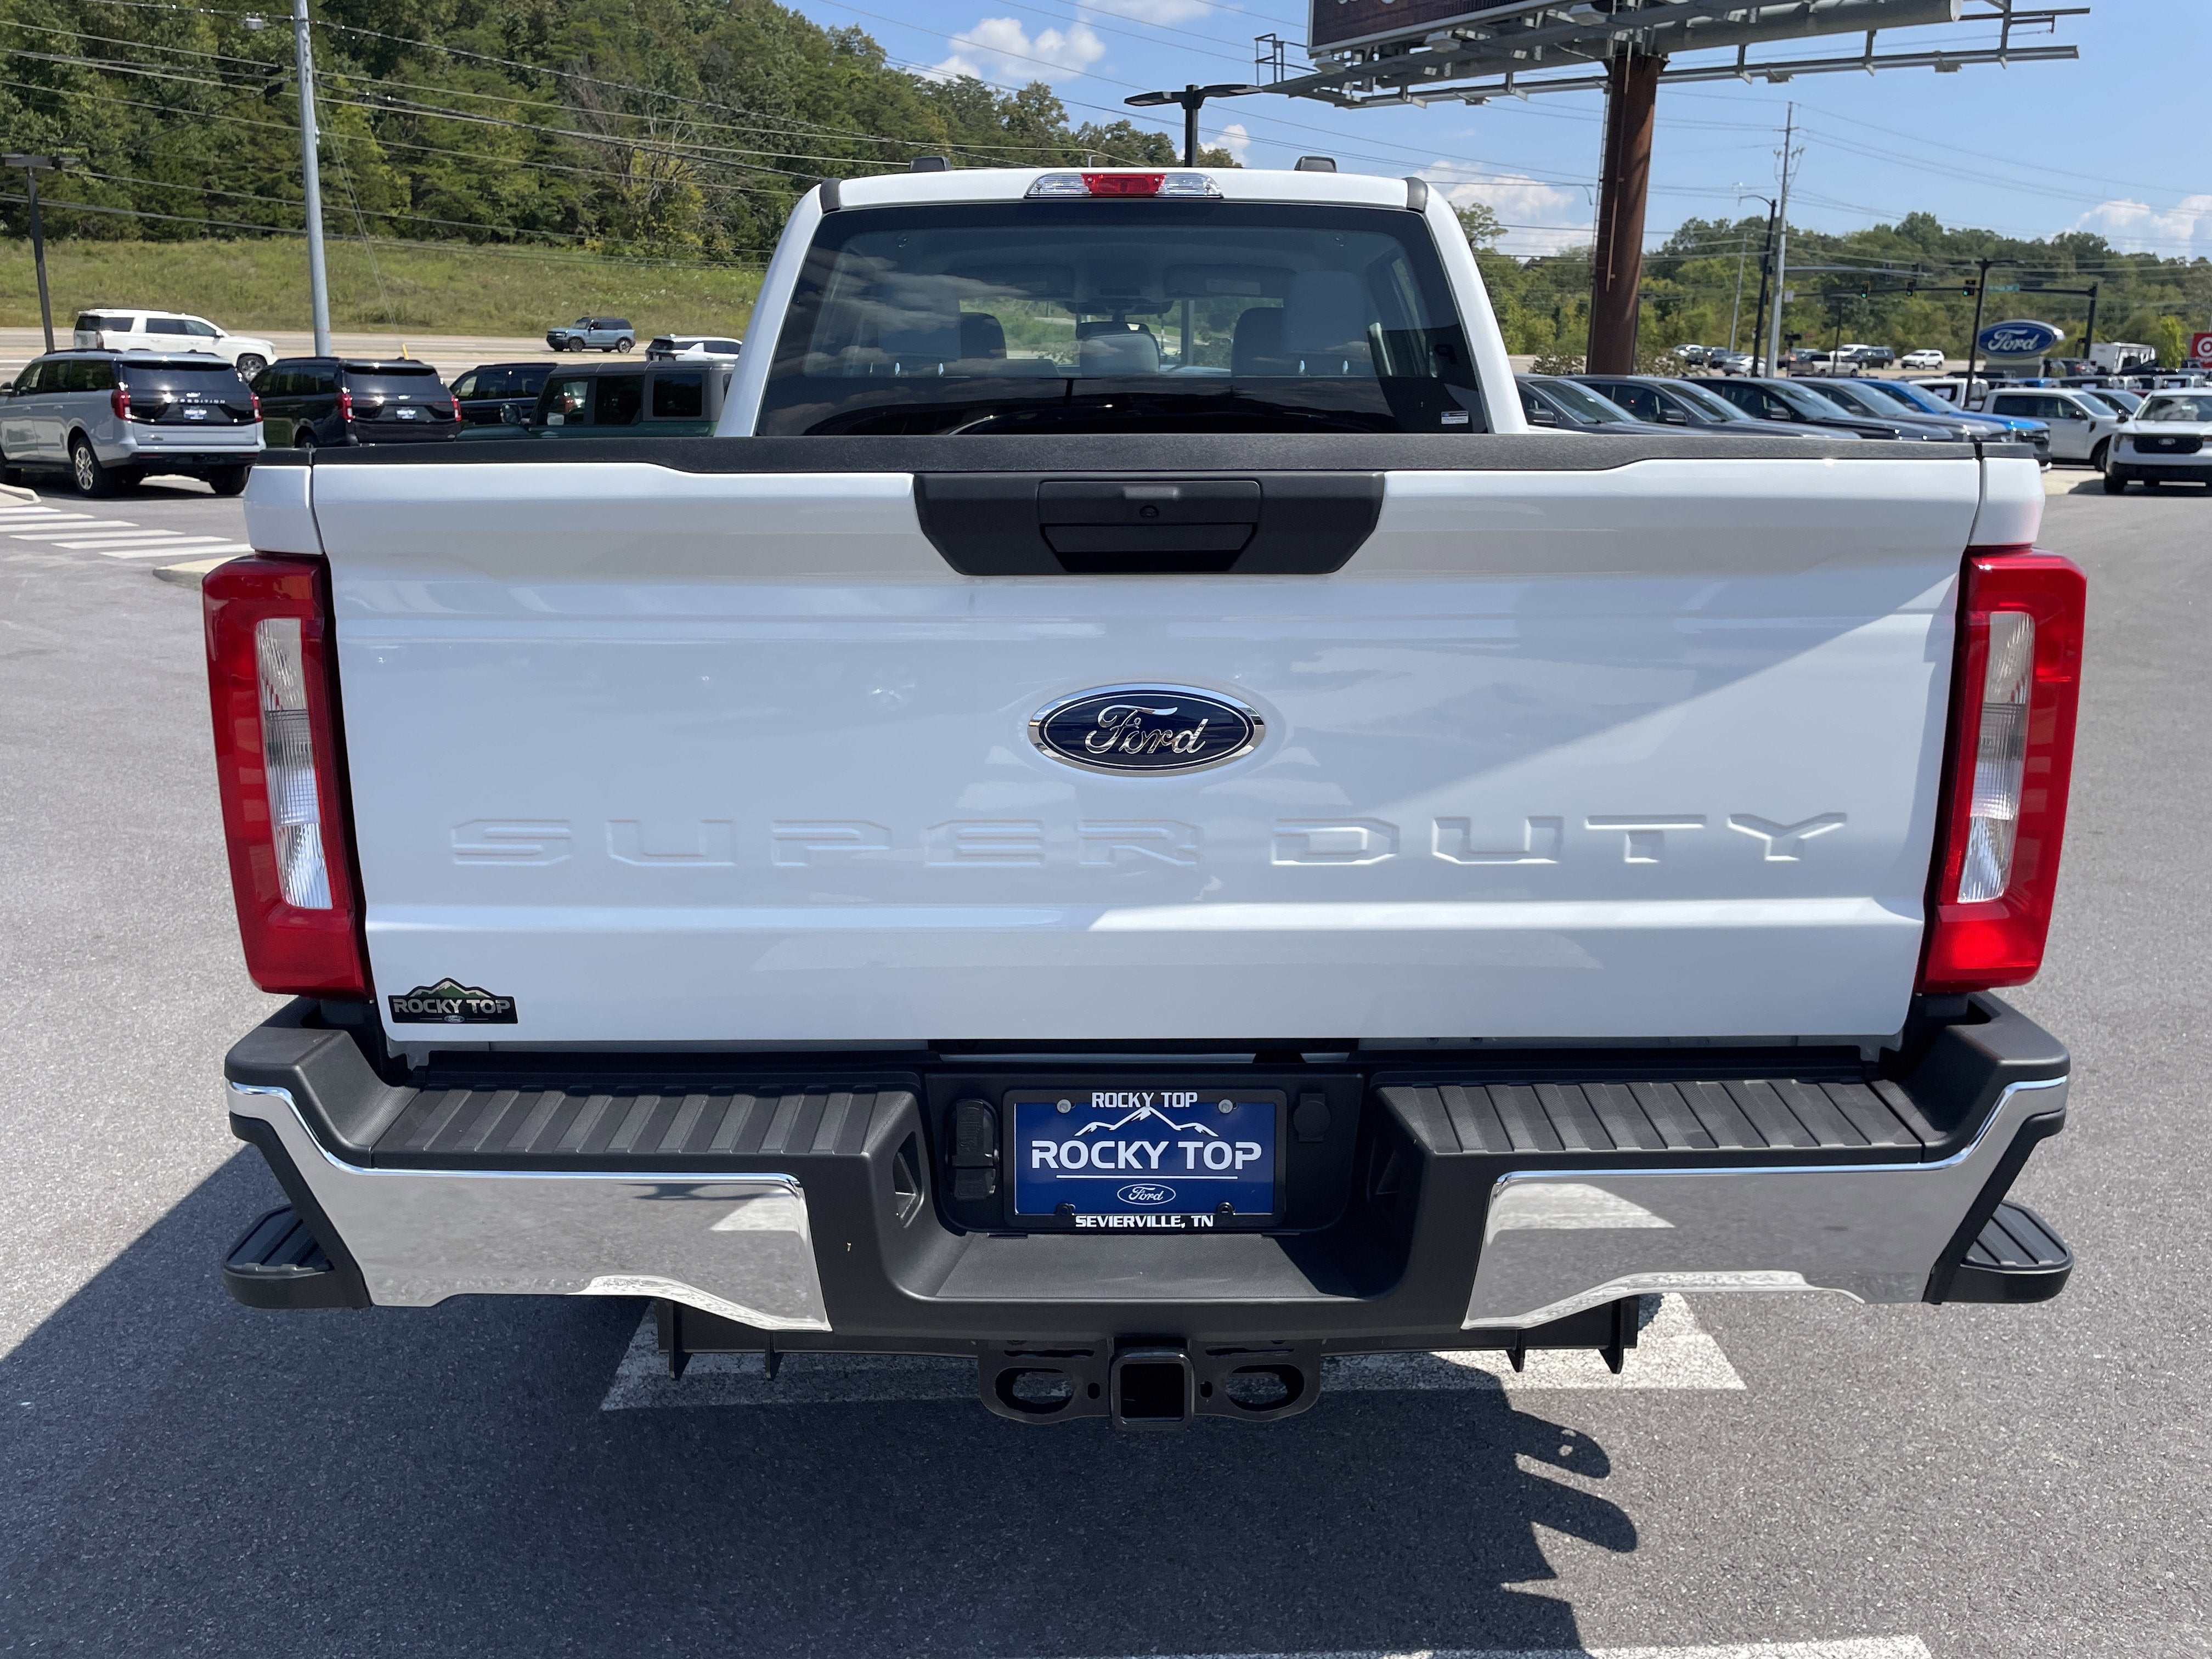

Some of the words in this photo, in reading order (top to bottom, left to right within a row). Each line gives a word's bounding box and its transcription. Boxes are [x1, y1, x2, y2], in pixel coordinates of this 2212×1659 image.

[1988, 329, 2040, 351] Ford
[1085, 704, 1209, 754] Ford
[450, 819, 1205, 867] SUPER
[1270, 812, 1848, 866] DUTY
[393, 998, 462, 1013] ROCKY
[466, 999, 511, 1013] TOP
[1092, 1092, 1154, 1108] ROCKY
[1161, 1092, 1198, 1107] TOP
[1031, 1140, 1169, 1170] ROCKY
[1178, 1141, 1262, 1170] TOP
[1128, 1186, 1164, 1200] Ford
[1075, 1215, 1186, 1228] SEVIERVILLE,
[1190, 1215, 1214, 1227] TN
